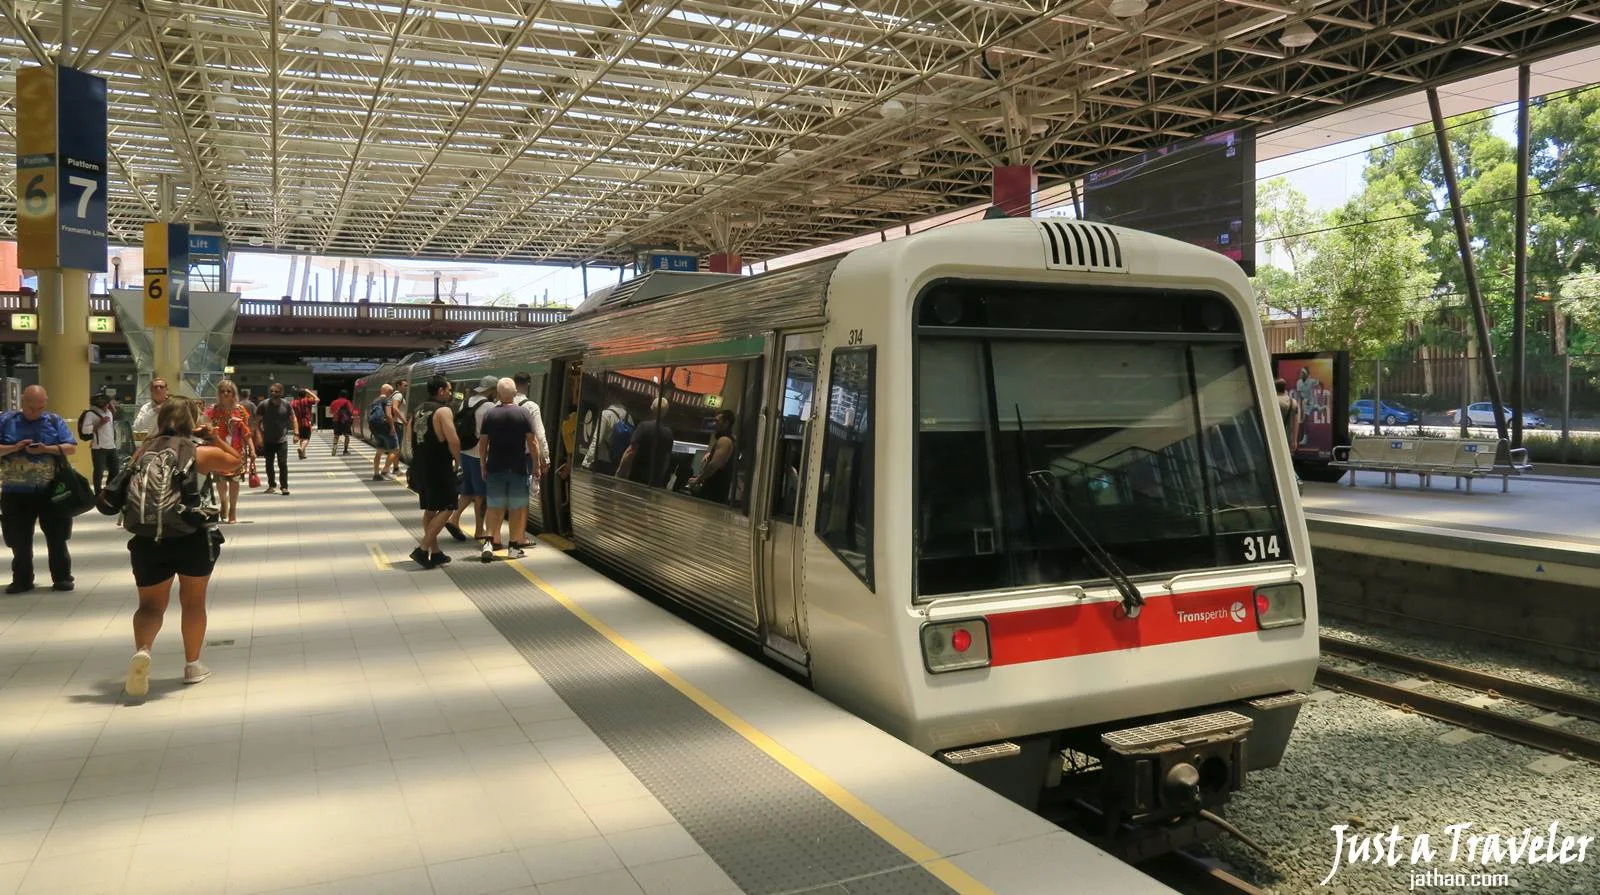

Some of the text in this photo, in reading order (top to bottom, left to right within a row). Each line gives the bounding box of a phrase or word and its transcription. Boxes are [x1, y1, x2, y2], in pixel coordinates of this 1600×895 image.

[67, 158, 99, 171] Platform
[25, 174, 49, 216] 6
[69, 175, 98, 219] 7
[190, 240, 208, 249] Lift
[148, 278, 163, 300] 6
[172, 278, 185, 301] 7
[848, 328, 864, 346] 314
[1243, 535, 1280, 561] 314
[1177, 607, 1228, 623] Transperth
